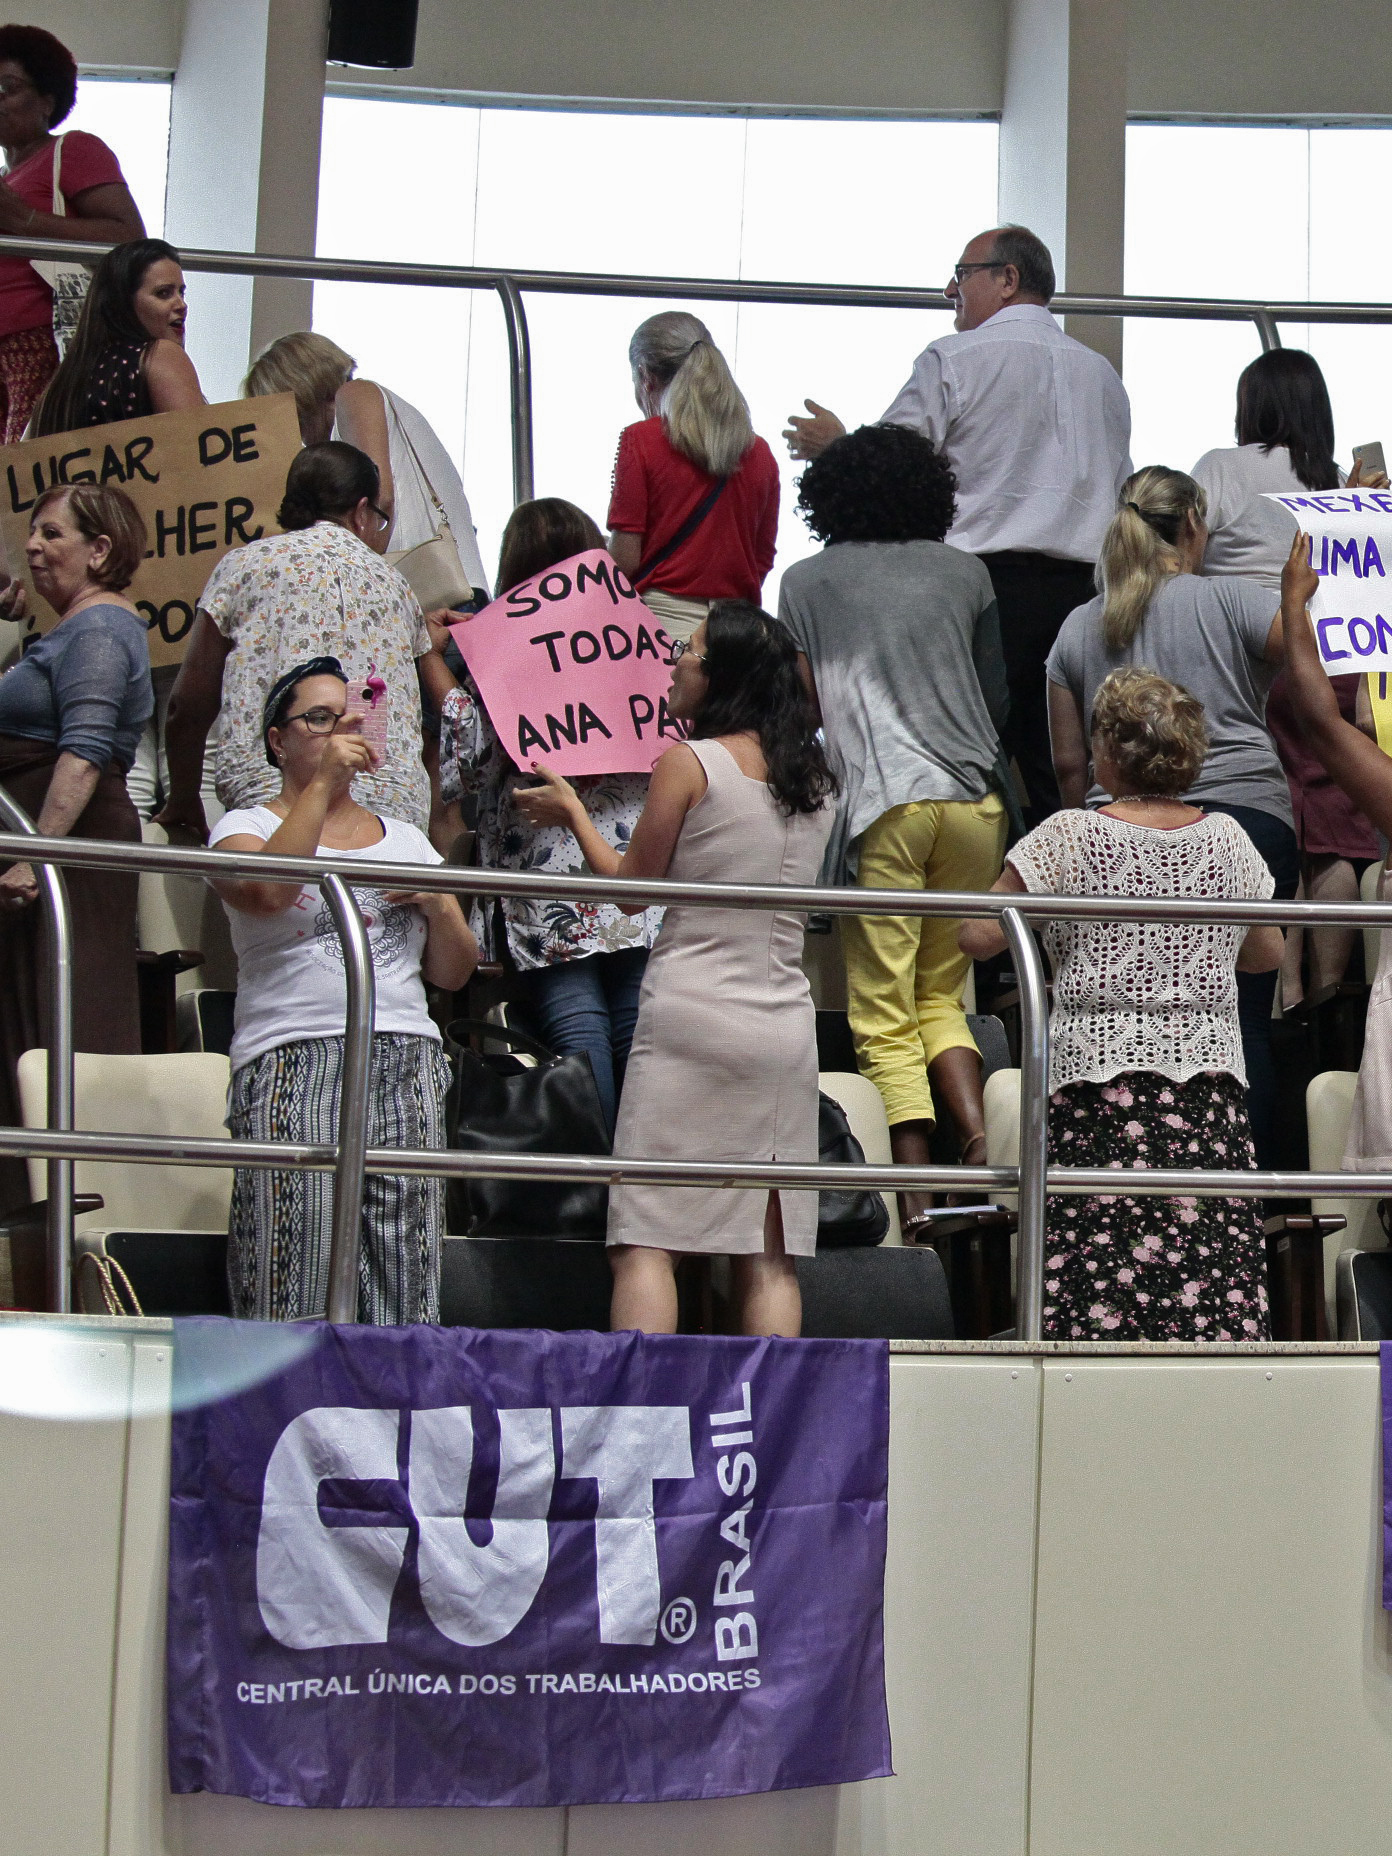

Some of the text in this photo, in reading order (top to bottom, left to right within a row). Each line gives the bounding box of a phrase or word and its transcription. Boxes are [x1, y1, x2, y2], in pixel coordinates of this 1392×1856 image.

[7, 423, 259, 513] LUGAR DE
[1308, 535, 1386, 578] UMA
[506, 559, 646, 617] SOMO
[530, 623, 676, 673] TODAS
[518, 702, 613, 757] ANA
[256, 1405, 695, 1650] CUT
[709, 1381, 759, 1662] BRASIL
[237, 1668, 761, 1704] CENTRAL ÚNICA DOS TRABALHADORES
